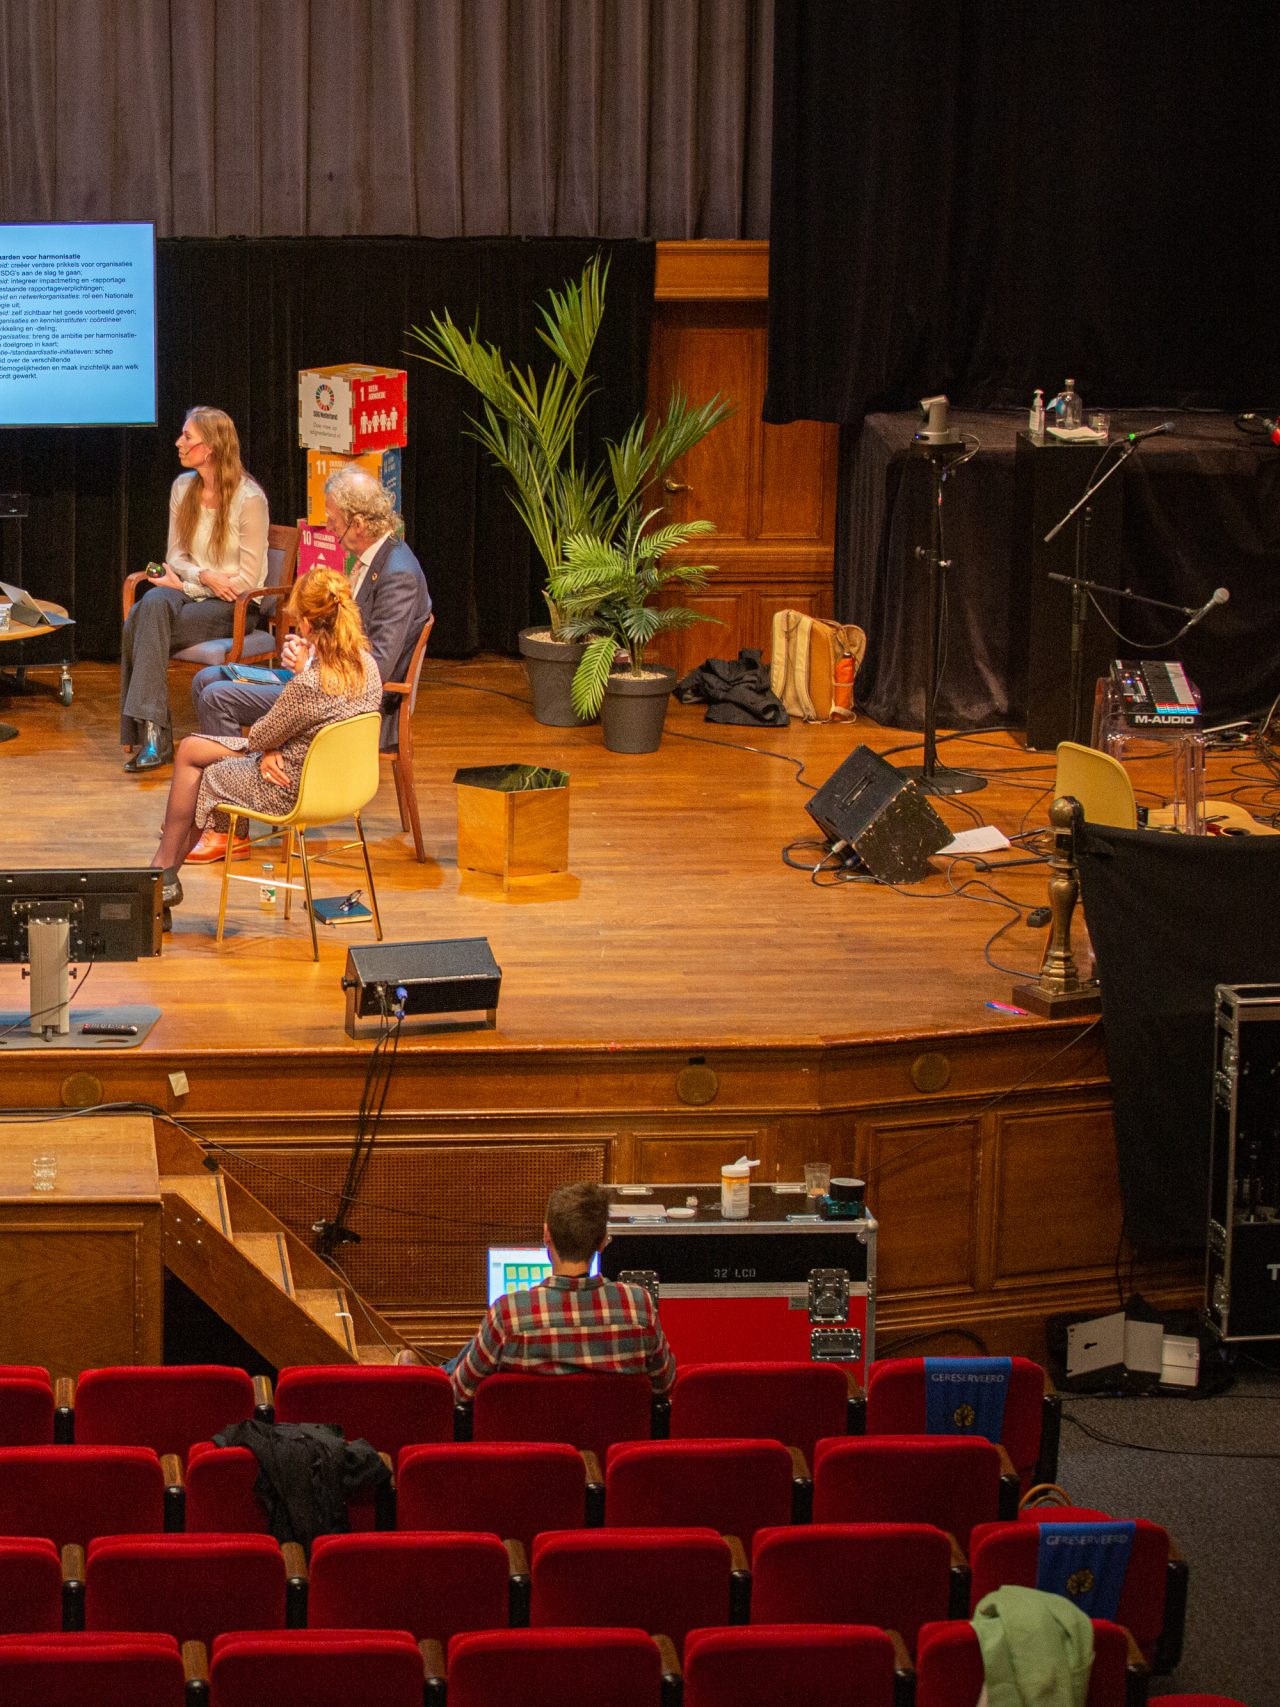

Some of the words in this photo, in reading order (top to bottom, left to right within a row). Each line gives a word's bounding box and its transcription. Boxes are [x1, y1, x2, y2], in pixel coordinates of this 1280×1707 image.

[360, 387, 364, 402] 1
[316, 460, 326, 474] 11
[1135, 715, 1194, 724] M-AUDIO
[735, 1269, 756, 1277] LCD
[931, 1373, 1005, 1383] GERESERVEERD
